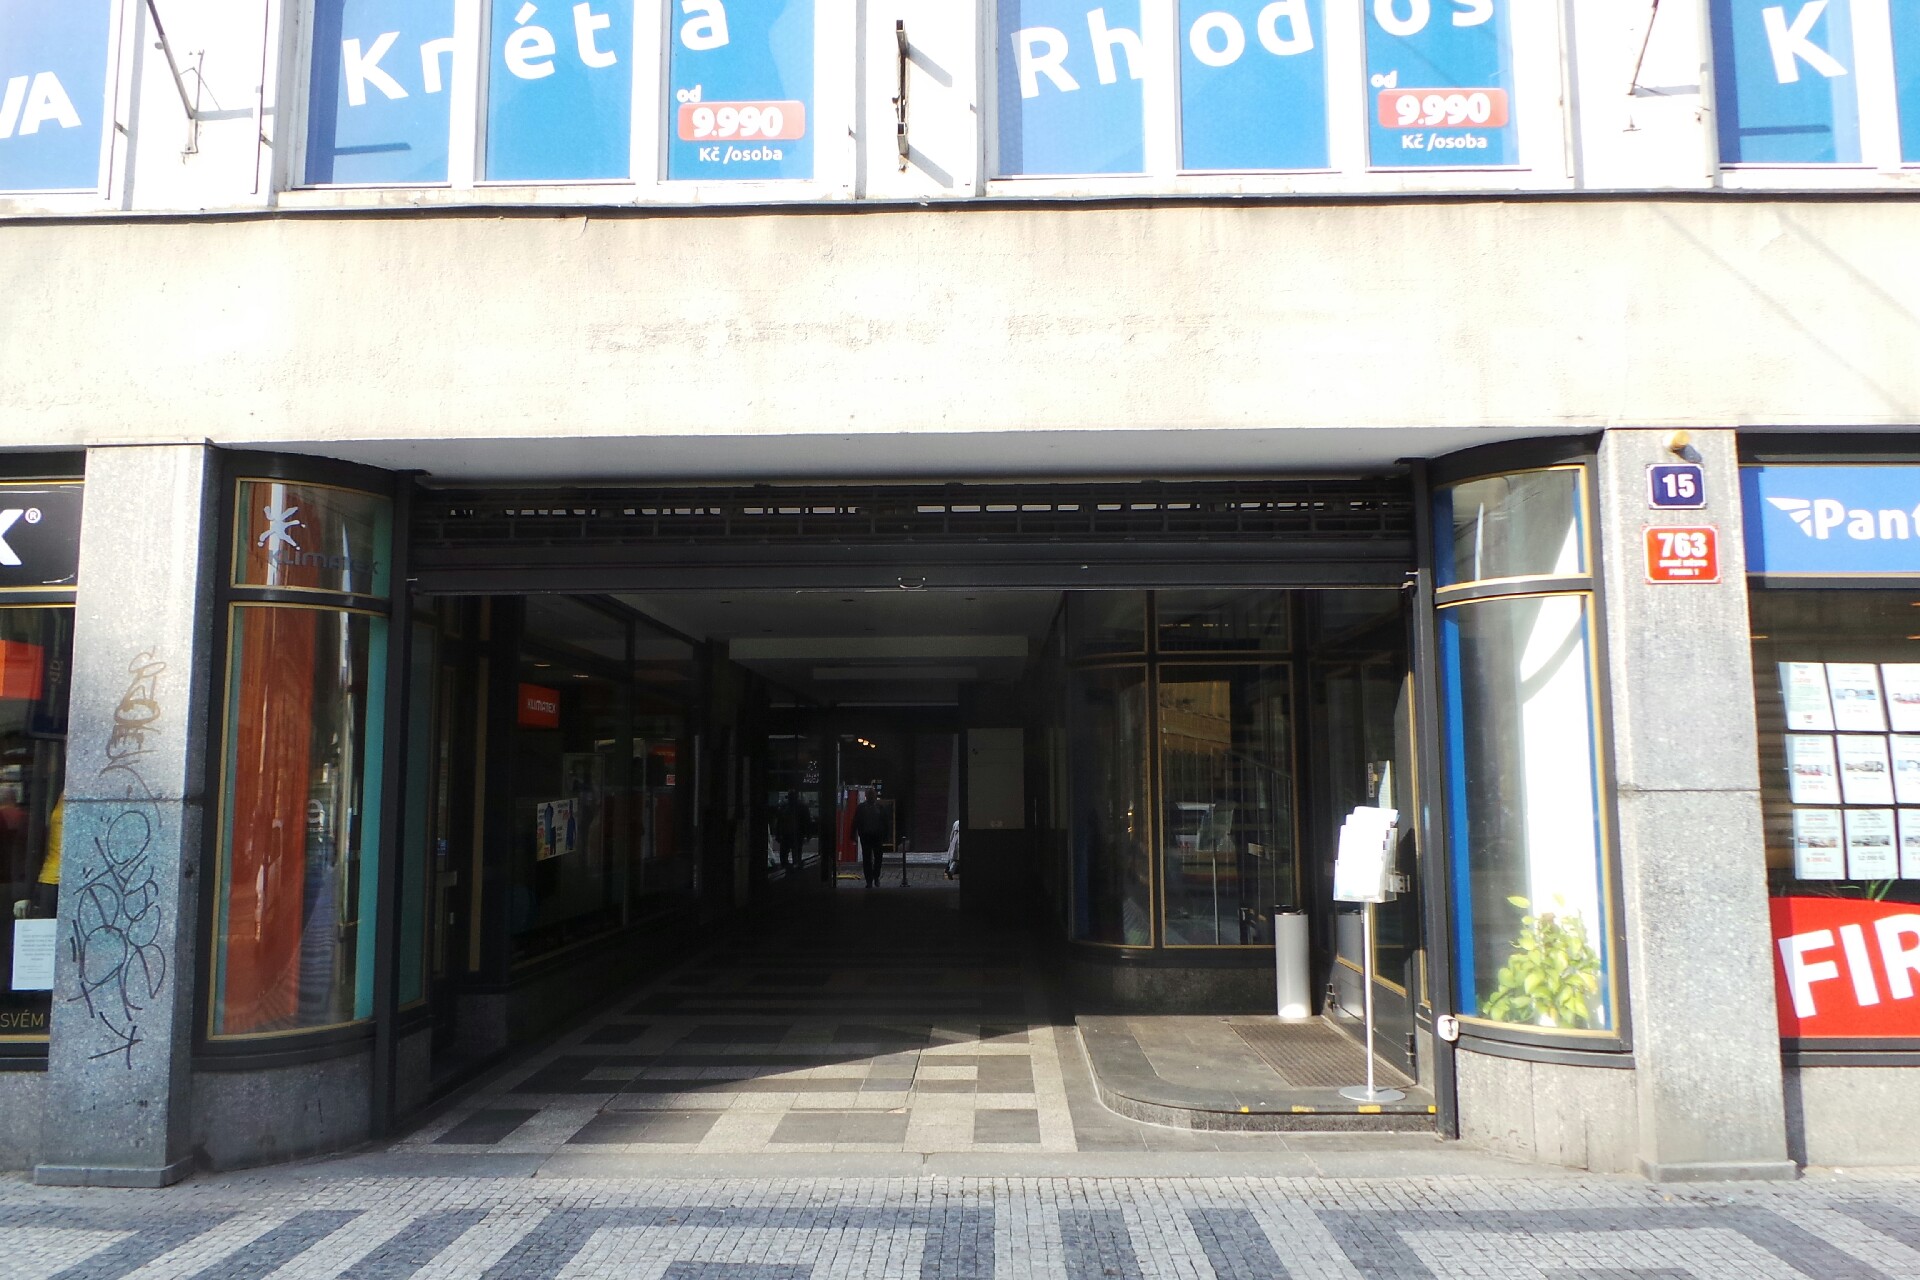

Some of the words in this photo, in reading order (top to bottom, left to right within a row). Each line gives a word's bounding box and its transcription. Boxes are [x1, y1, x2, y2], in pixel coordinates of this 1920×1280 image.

[1762, 0, 1848, 84] K
[1370, 70, 1397, 89] od
[676, 84, 702, 103] od
[1395, 92, 1491, 126] 9.990
[692, 106, 784, 138] 9.990
[1402, 133, 1424, 149] Kč
[1427, 133, 1488, 151] /osoba
[699, 146, 720, 162] Kč
[722, 145, 783, 165] /osoba
[1662, 473, 1696, 498] 15
[1657, 532, 1708, 558] 763
[0, 1009, 44, 1028] SVÉM
